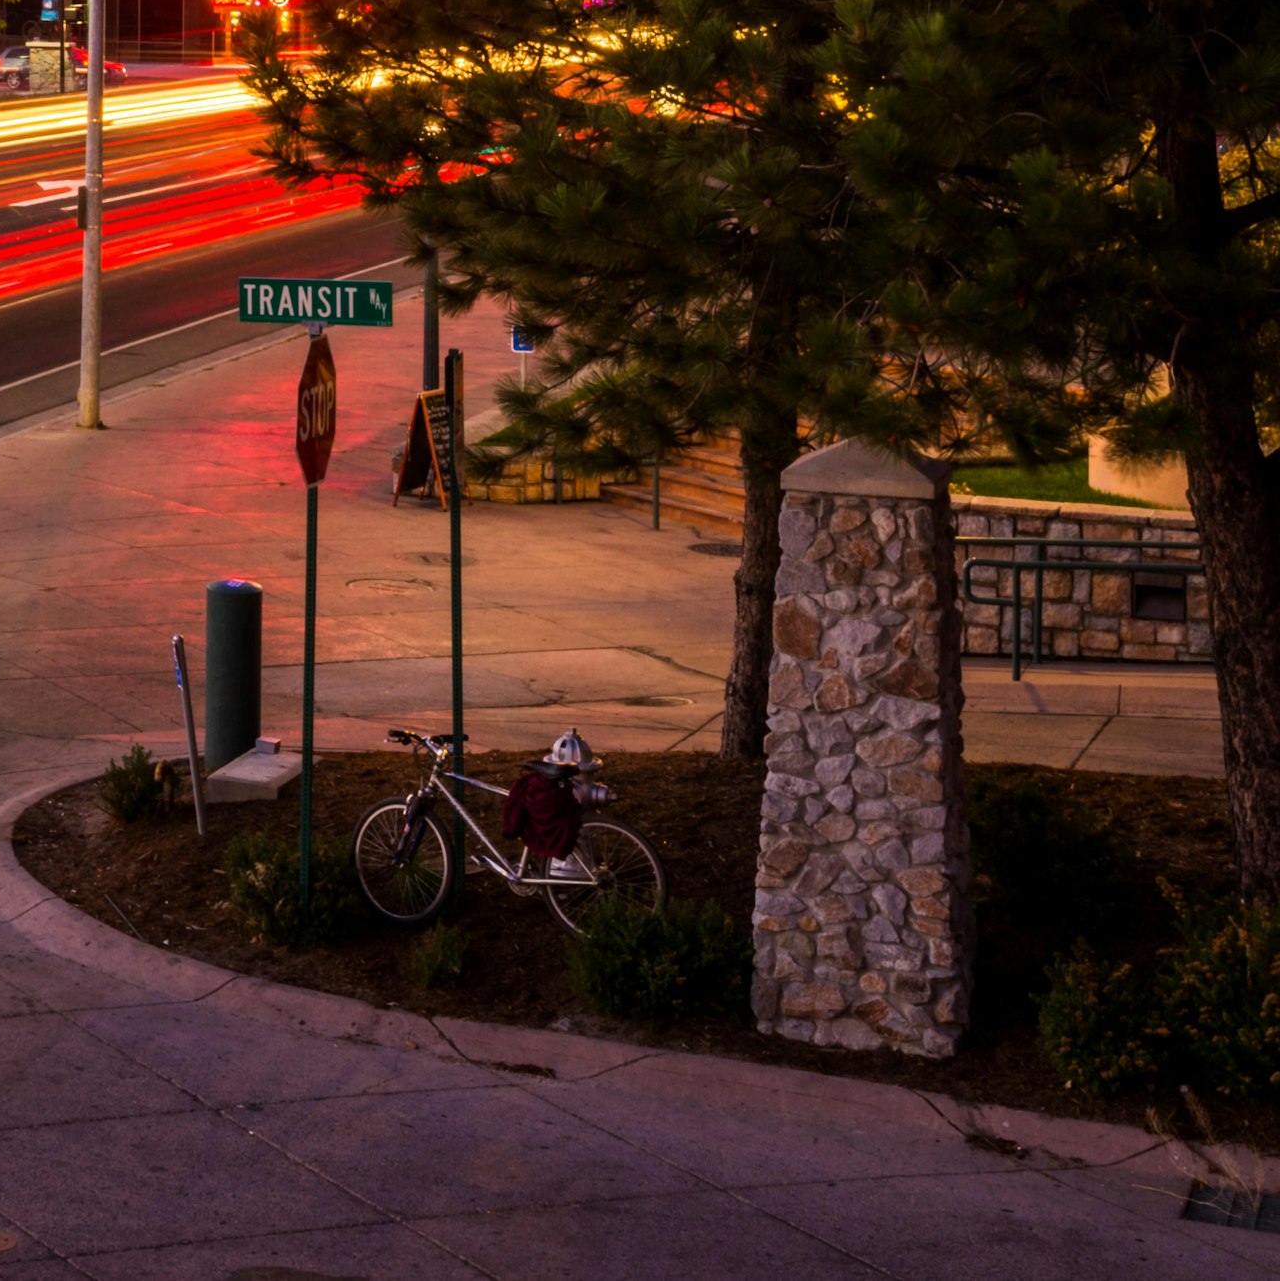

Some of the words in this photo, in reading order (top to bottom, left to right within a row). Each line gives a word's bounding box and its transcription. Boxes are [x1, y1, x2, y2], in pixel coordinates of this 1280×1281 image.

[243, 284, 358, 318] TRANSIT
[368, 287, 387, 320] WAY
[299, 381, 336, 442] STOP
